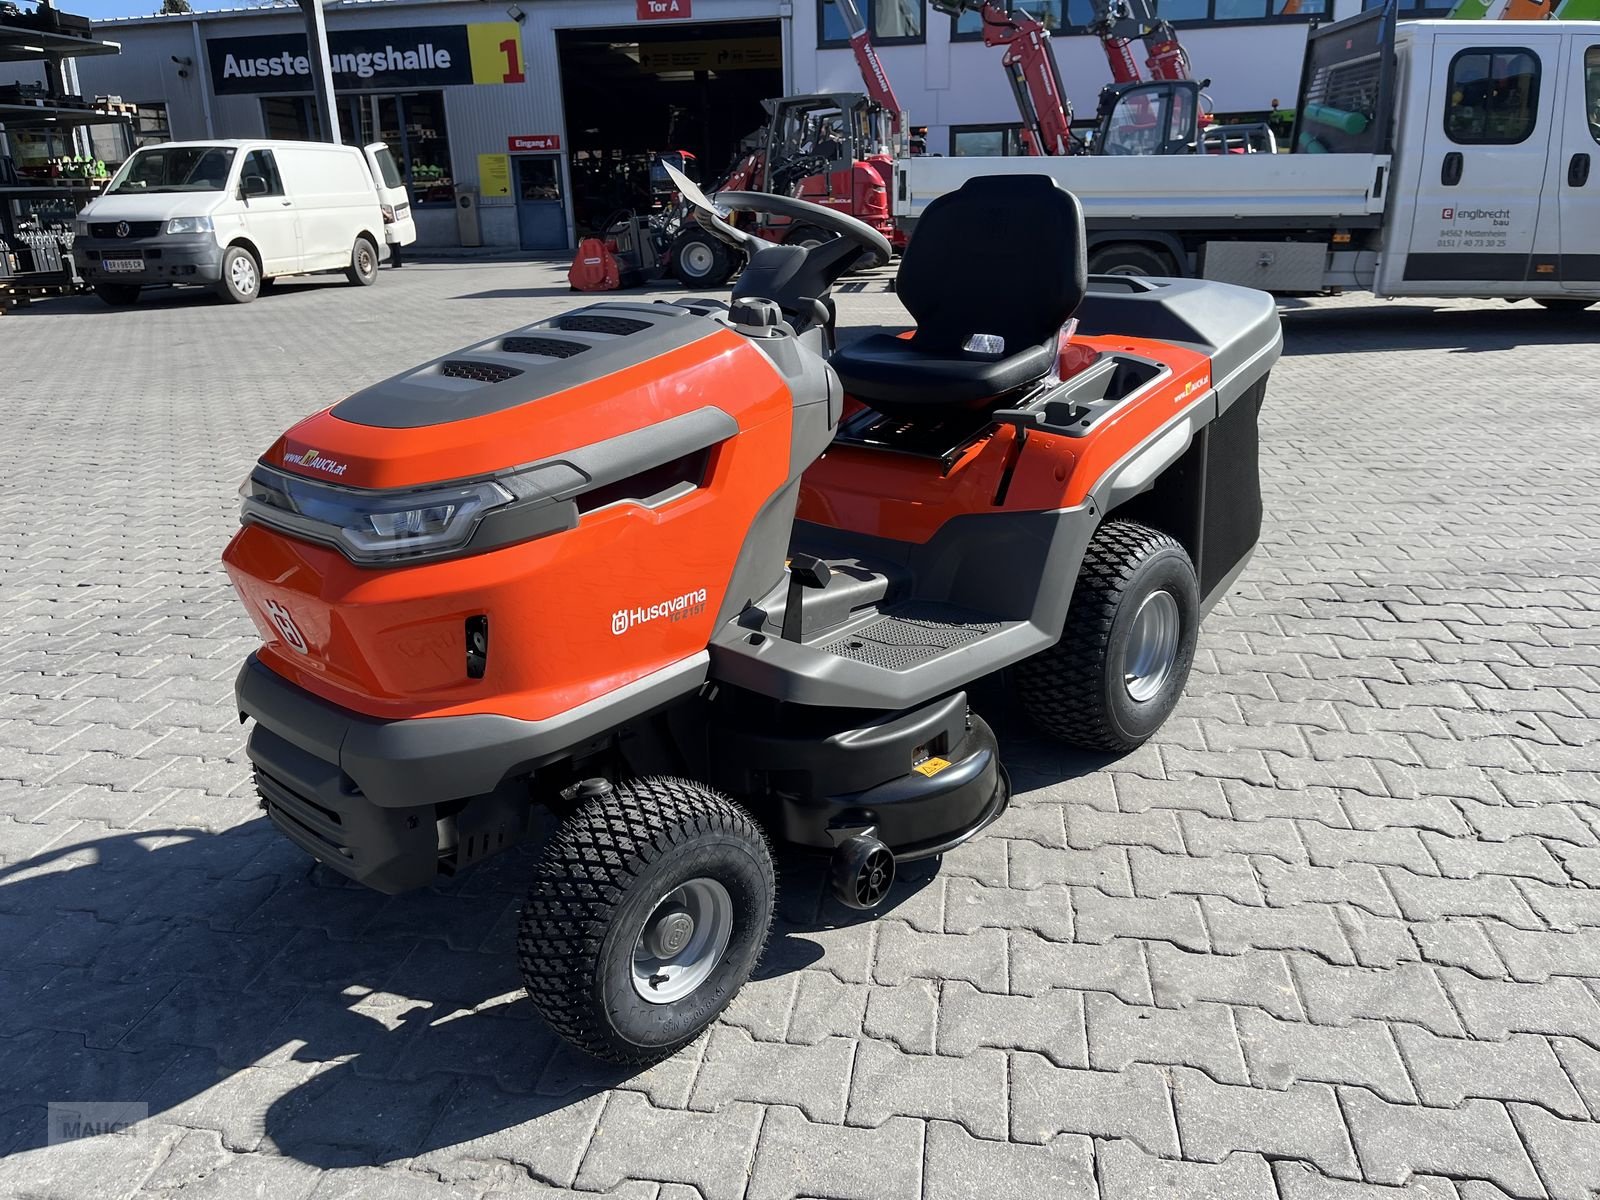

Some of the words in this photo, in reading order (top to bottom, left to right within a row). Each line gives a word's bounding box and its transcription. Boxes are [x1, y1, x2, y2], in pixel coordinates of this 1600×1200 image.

[647, 1, 667, 13] Tor
[670, 1, 680, 12] A
[223, 43, 452, 79] Aussteungshalle
[499, 38, 526, 84] 1
[863, 43, 889, 93] WEIDEMANN
[515, 139, 546, 149] Eingang
[546, 138, 554, 147] A
[1457, 209, 1510, 220] englbrecht
[1492, 219, 1510, 227] bau
[283, 449, 348, 476] www.MAUCH.at
[629, 588, 707, 627] Husqvarna
